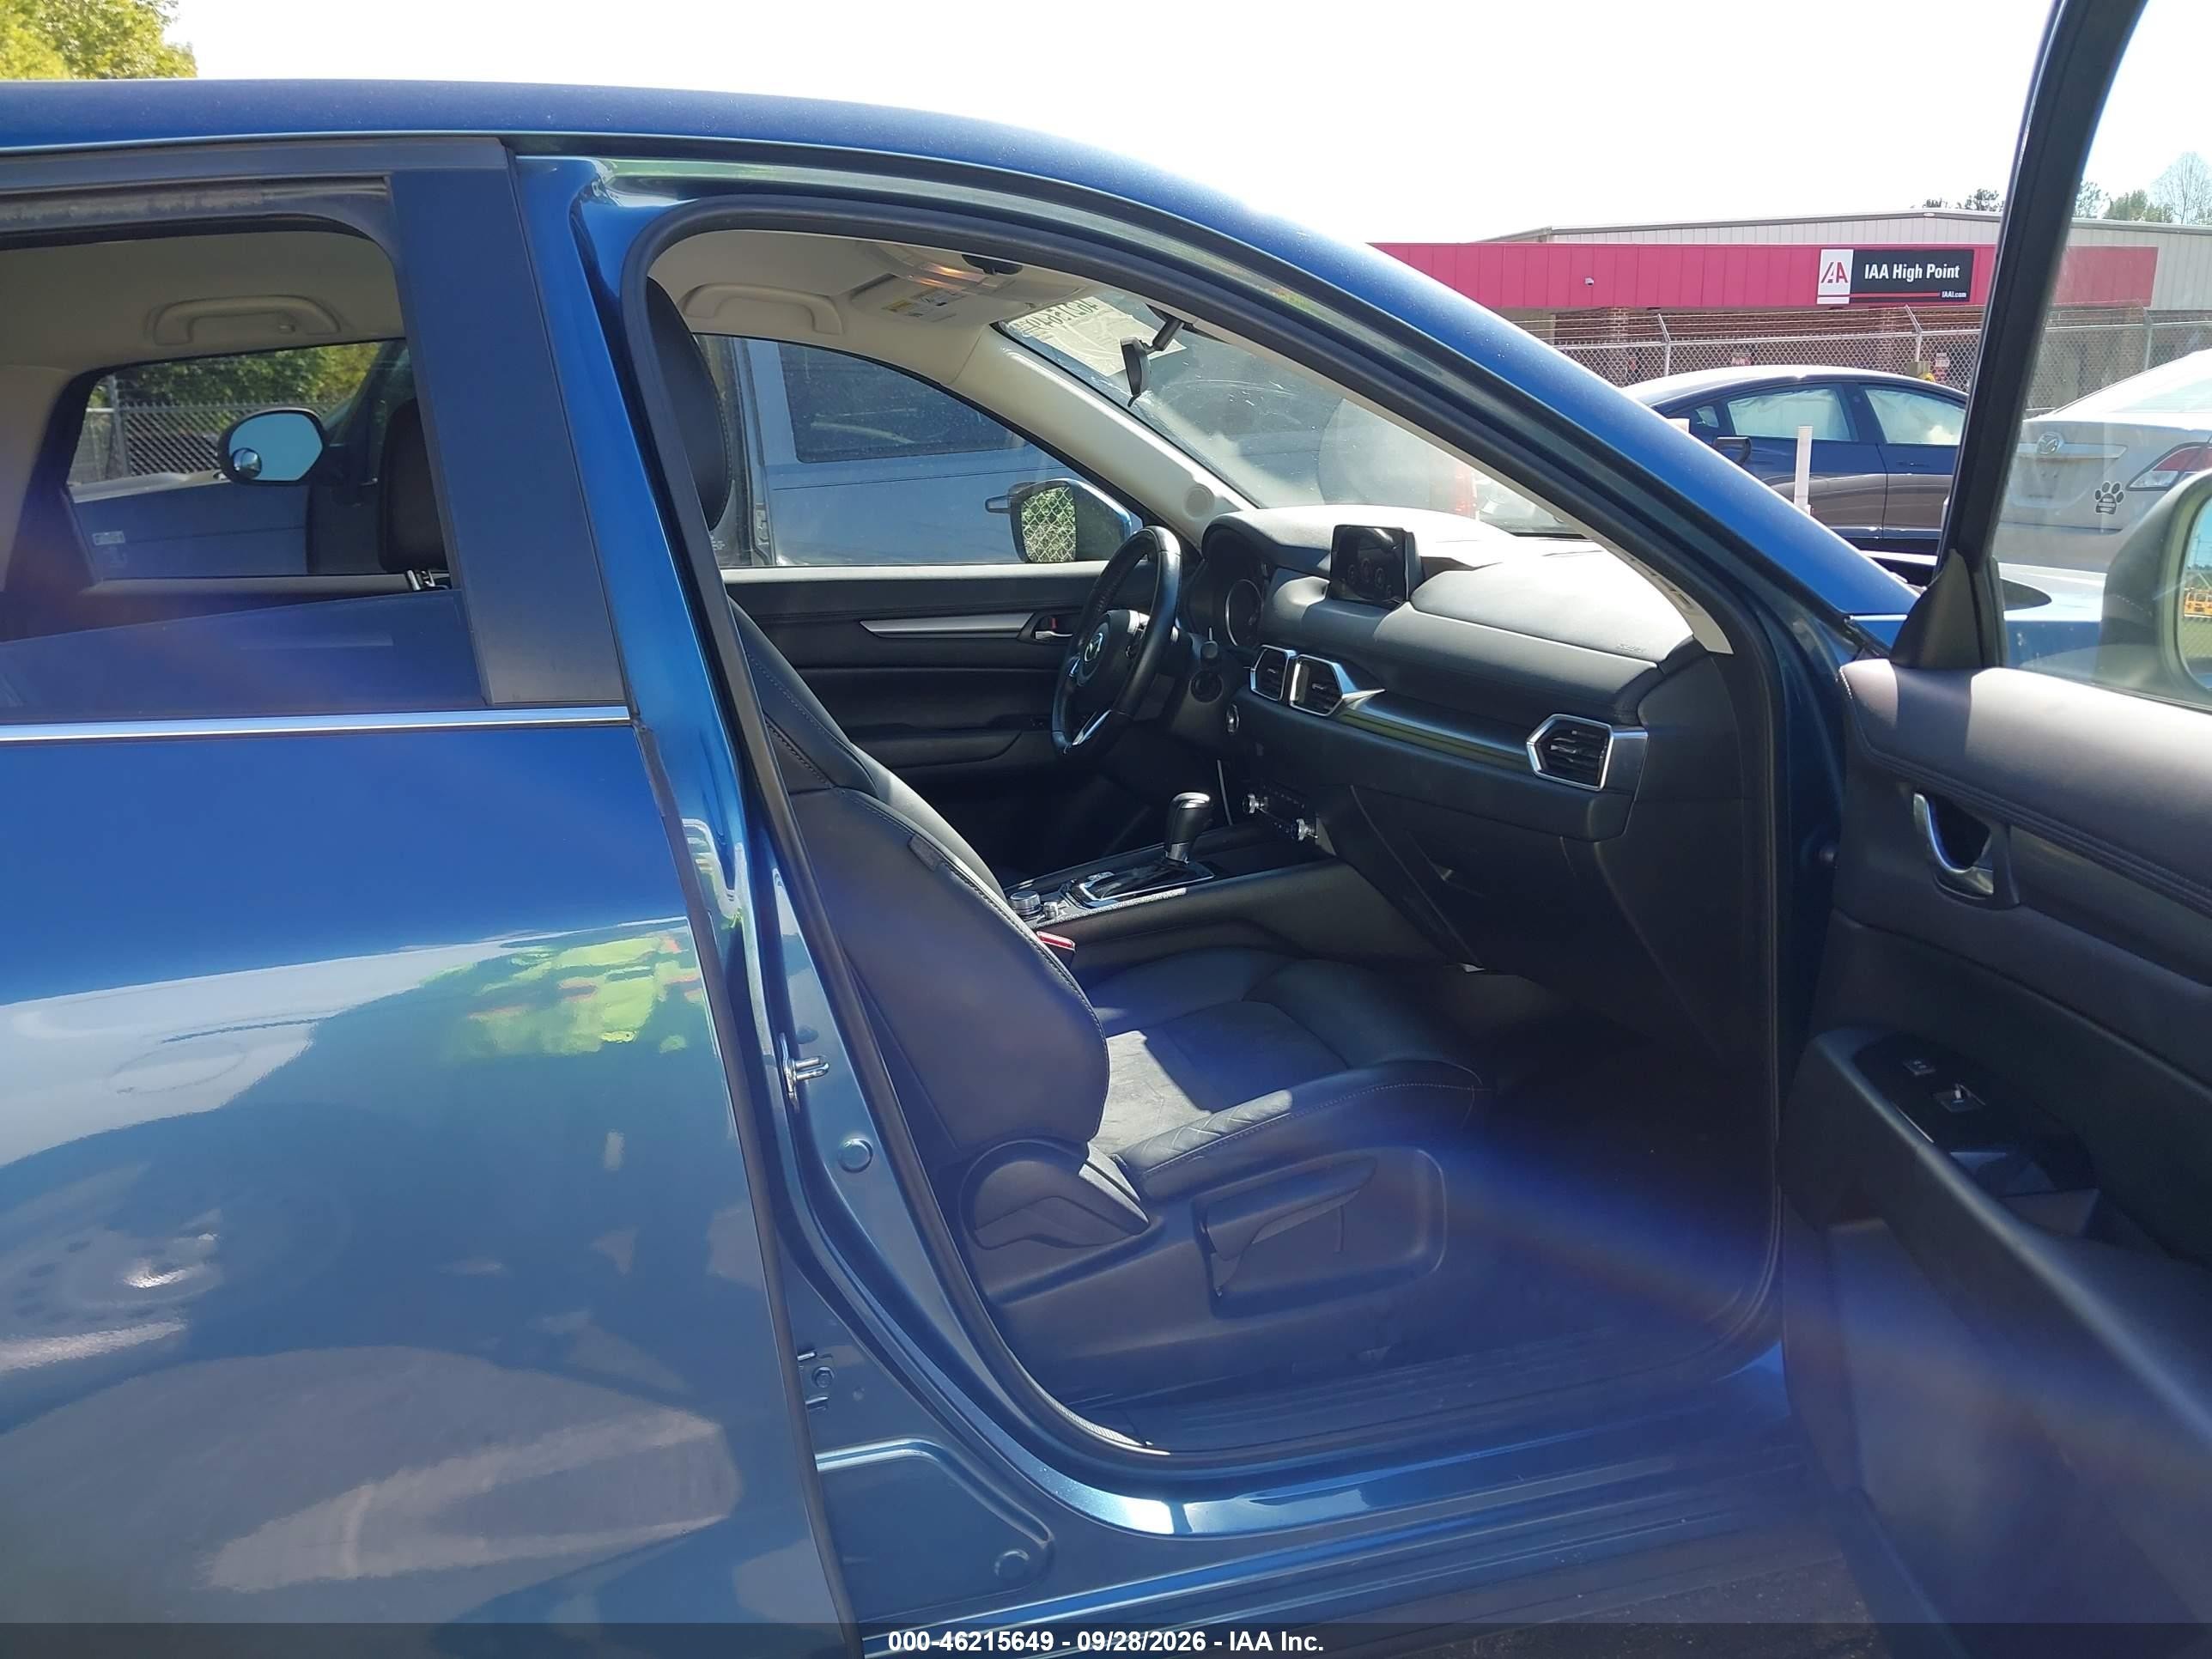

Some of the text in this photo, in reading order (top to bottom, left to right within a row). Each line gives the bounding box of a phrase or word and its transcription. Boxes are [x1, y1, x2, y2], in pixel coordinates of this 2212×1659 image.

[1864, 263, 1960, 283] IAA High Point
